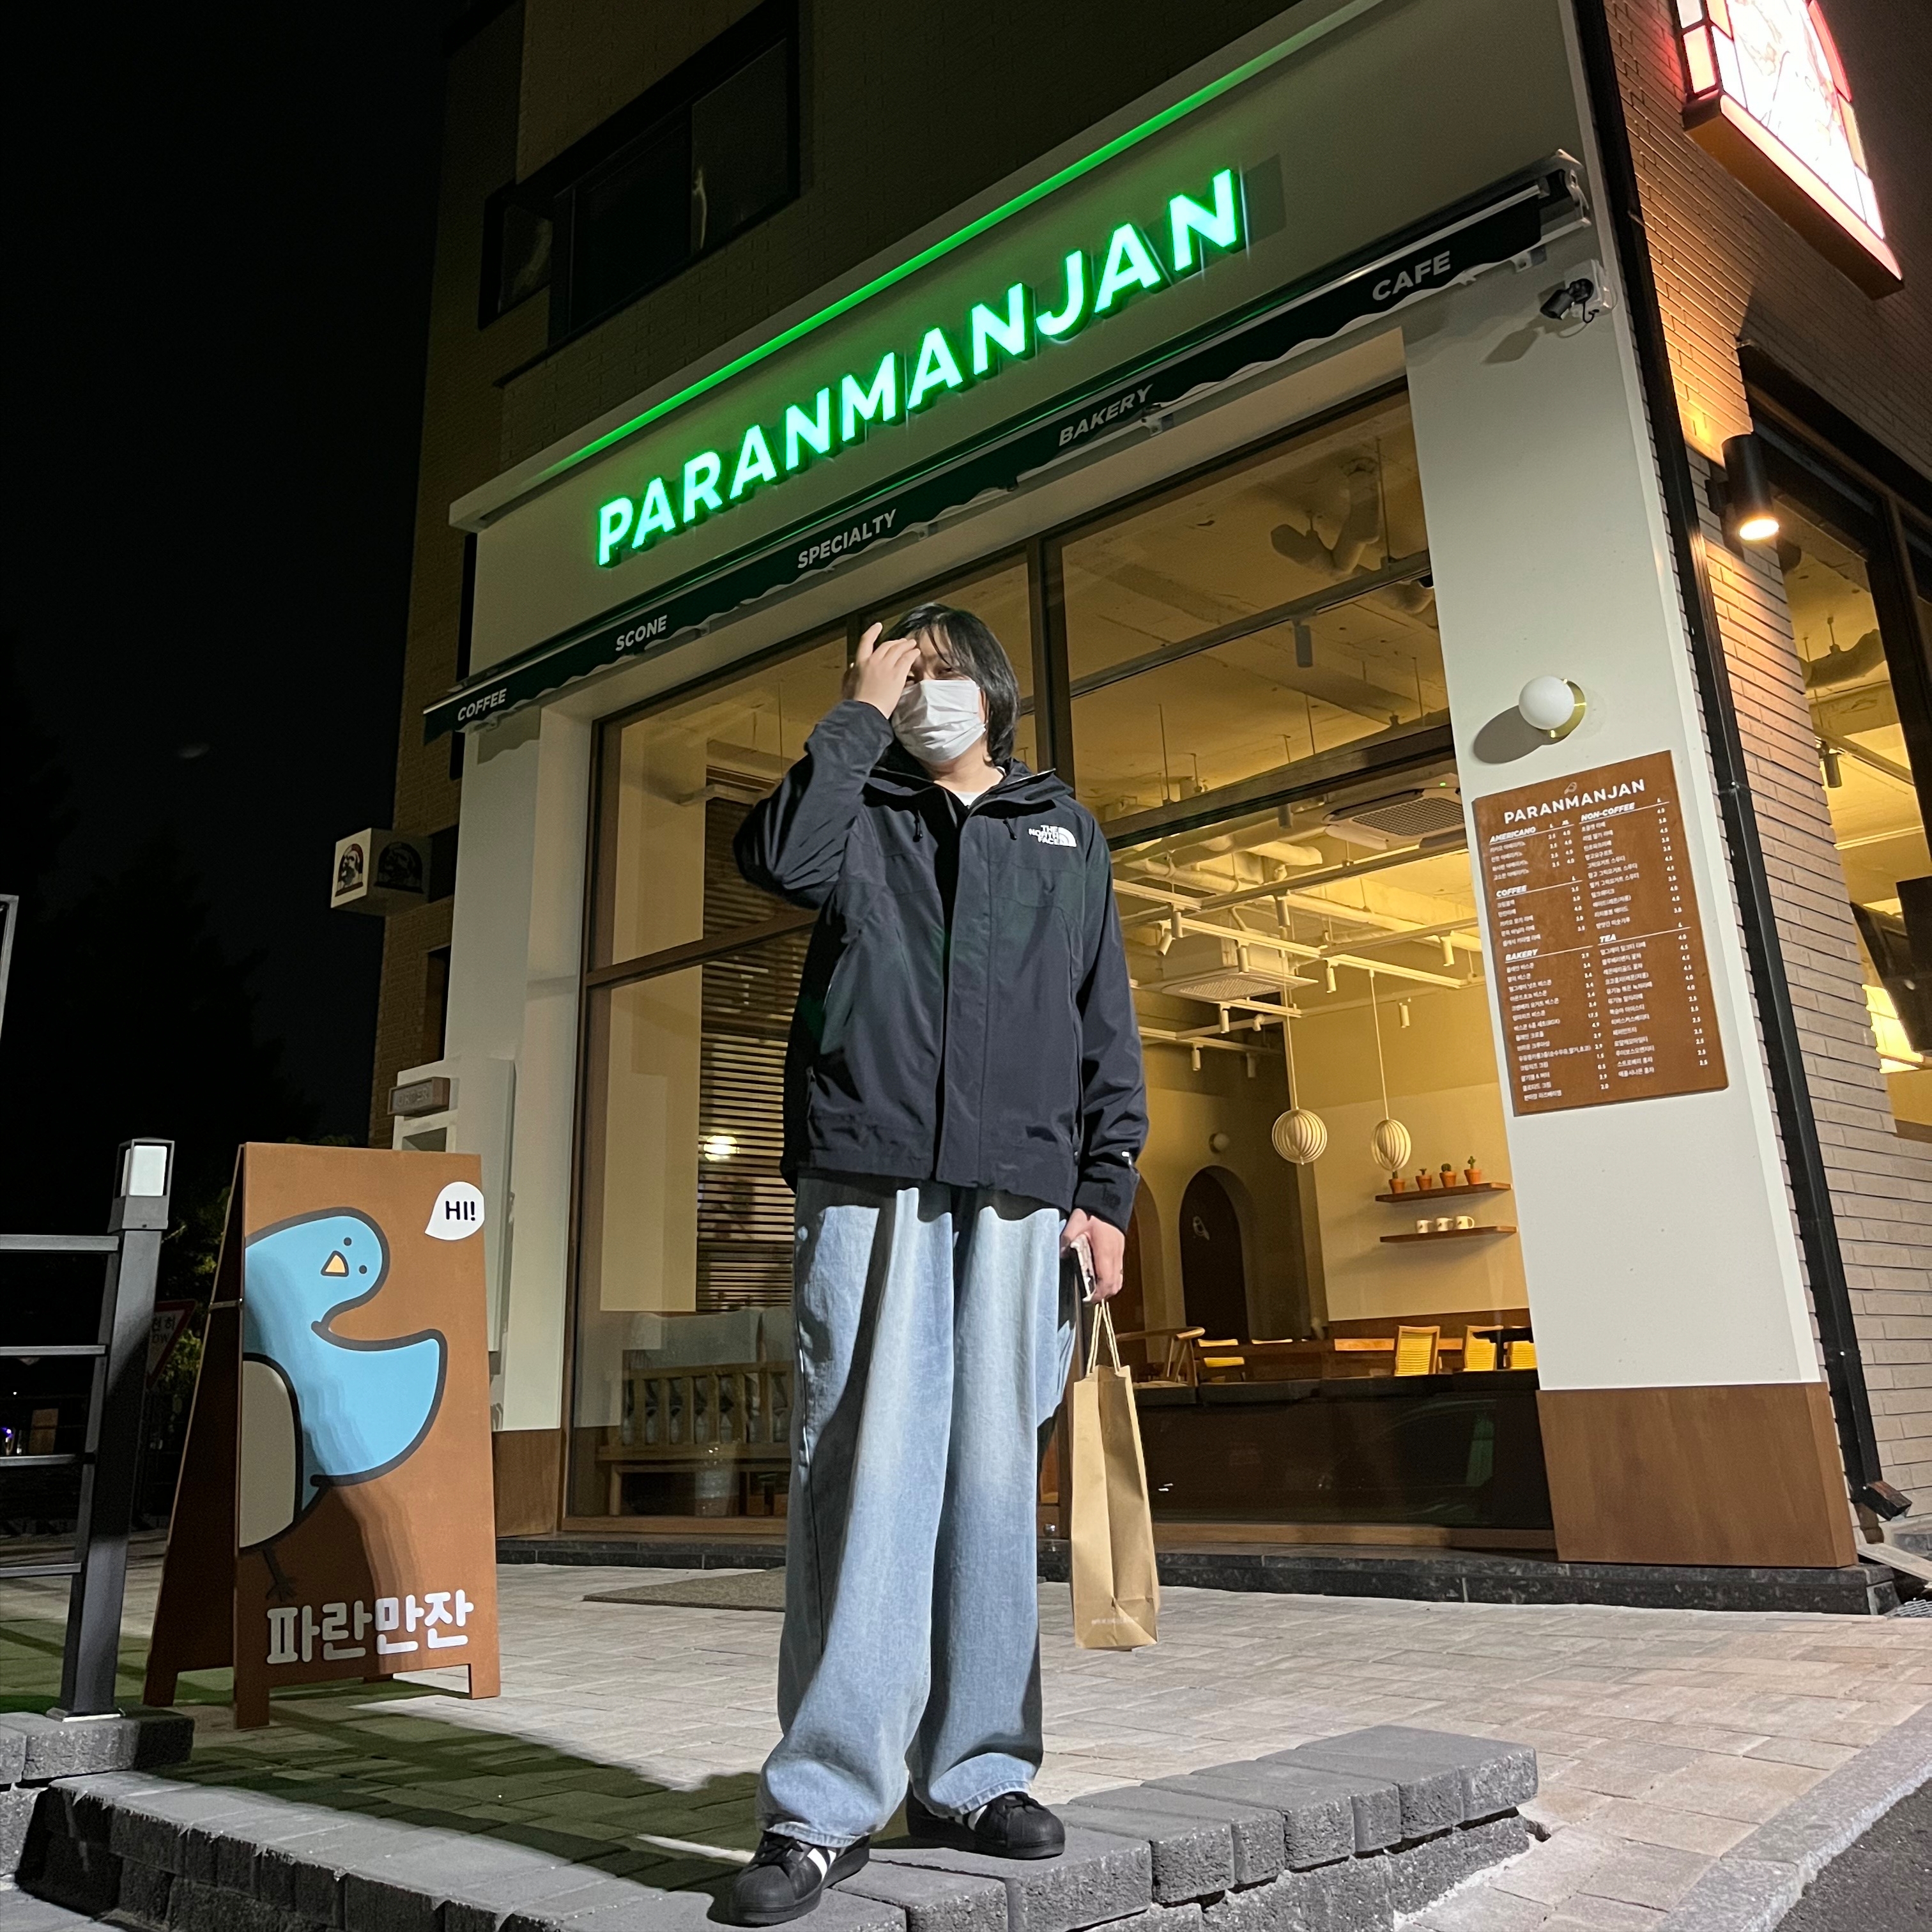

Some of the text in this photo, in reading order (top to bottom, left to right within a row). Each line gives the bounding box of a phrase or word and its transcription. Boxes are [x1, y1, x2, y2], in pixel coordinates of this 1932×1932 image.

[1372, 250, 1451, 301] CAFE
[597, 167, 1242, 567] PARANMANJAN
[1059, 383, 1153, 447] BAKERY
[797, 509, 896, 569] SPECIALTY
[615, 615, 667, 651] SCONE
[457, 688, 507, 721] COFFEE
[1503, 778, 1645, 824] PARANMANJAN
[1580, 801, 1636, 822] NON-COFFEE
[1038, 836, 1059, 845] FACE
[1489, 825, 1537, 843] AMERICANO
[1496, 884, 1528, 897] COFFEE
[1505, 948, 1538, 961] BAKERY
[1598, 933, 1616, 943] TEA
[445, 1200, 475, 1221] HI!
[266, 1589, 475, 1664] 파란만잔
